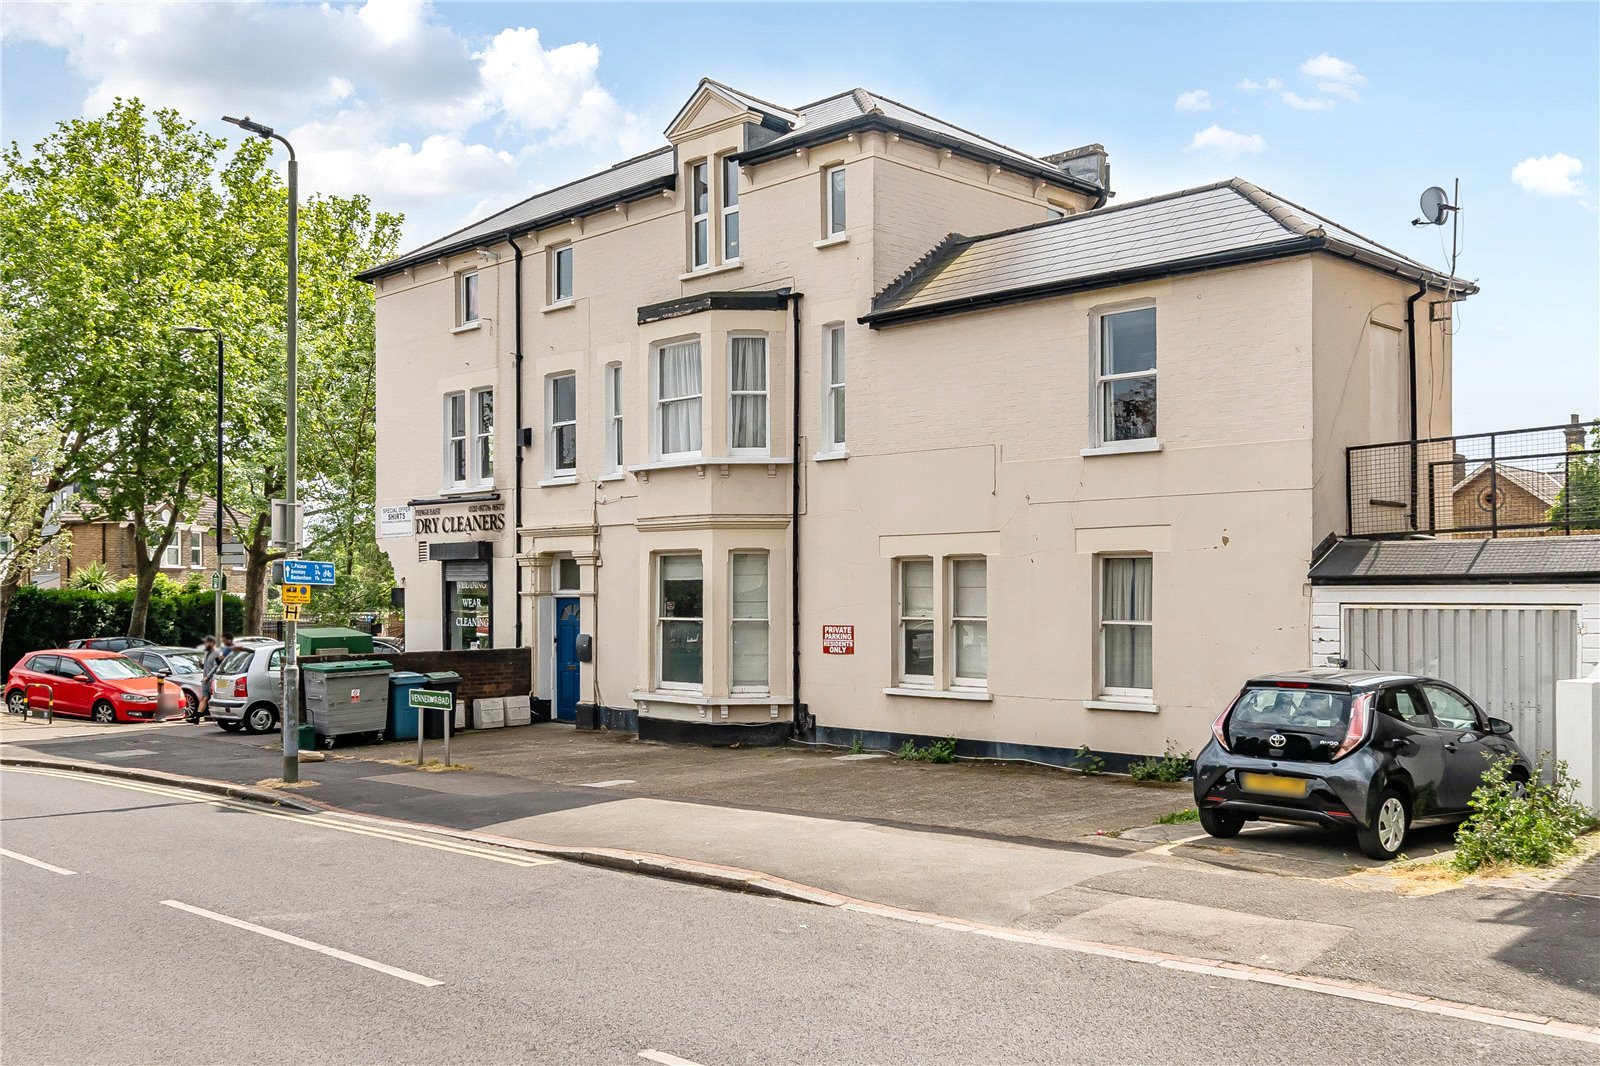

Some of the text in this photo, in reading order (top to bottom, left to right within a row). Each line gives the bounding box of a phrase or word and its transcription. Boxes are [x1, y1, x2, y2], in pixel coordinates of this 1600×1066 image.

[387, 512, 406, 521] SHIRTS
[415, 513, 506, 535] DRY CLEANERS
[461, 598, 482, 608] WEAR
[456, 617, 489, 627] CLEANING
[824, 626, 852, 634] PRIVATE
[433, 696, 450, 705] ROAD
